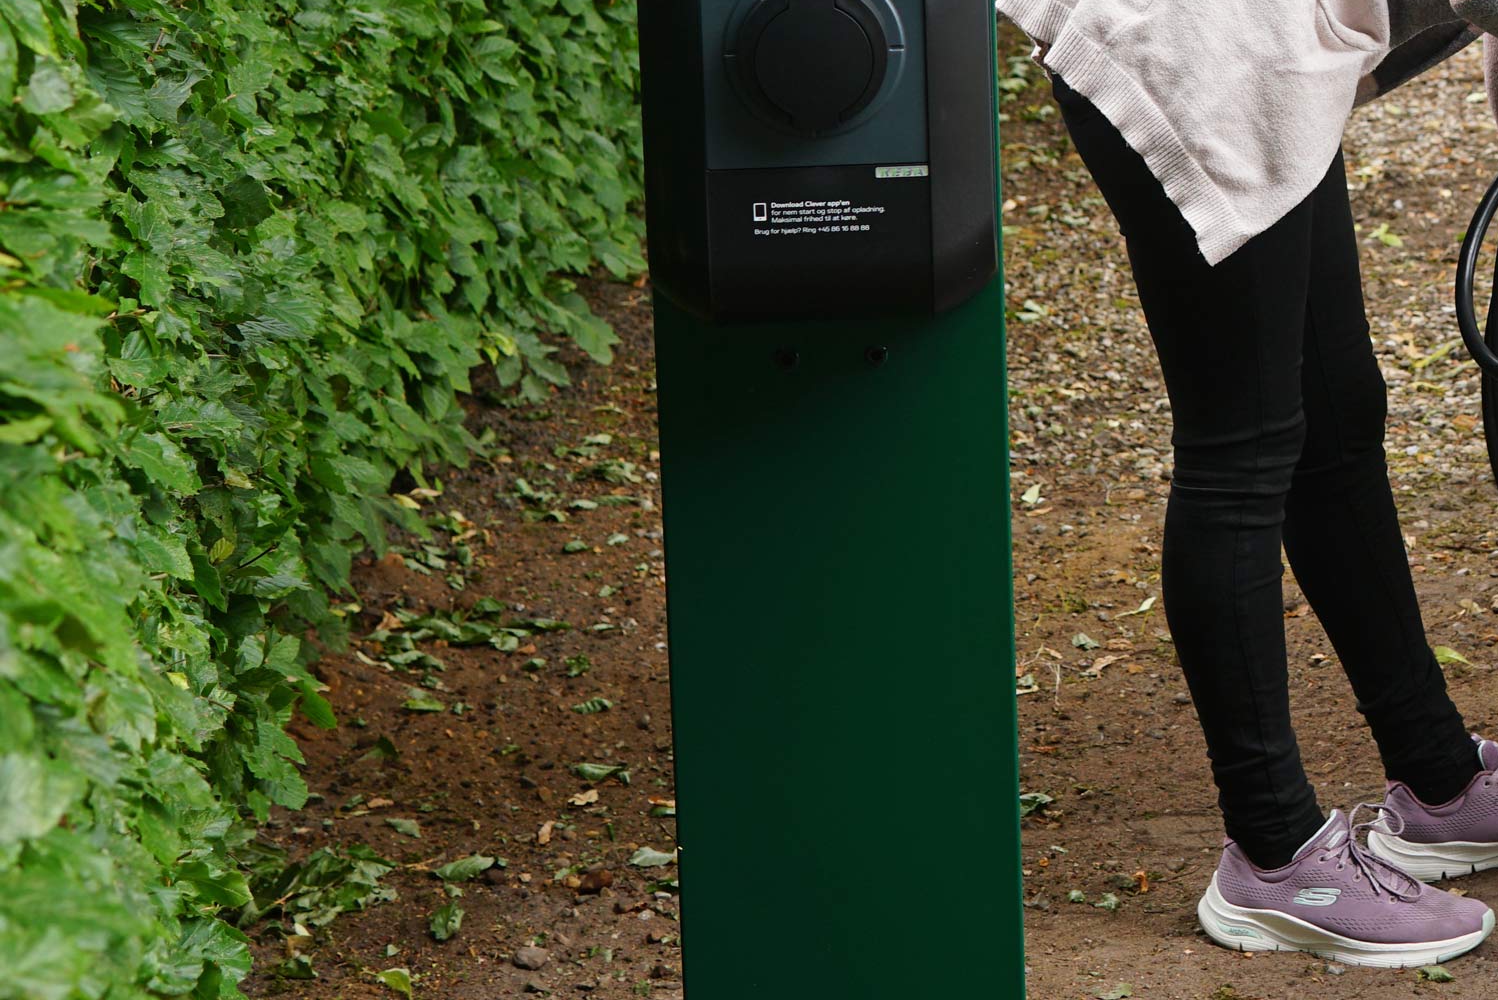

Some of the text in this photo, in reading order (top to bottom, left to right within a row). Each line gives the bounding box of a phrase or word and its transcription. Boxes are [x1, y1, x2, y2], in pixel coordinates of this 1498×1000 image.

[827, 207, 842, 215] stop
[852, 206, 885, 214] opladning.
[754, 228, 769, 236] Brug
